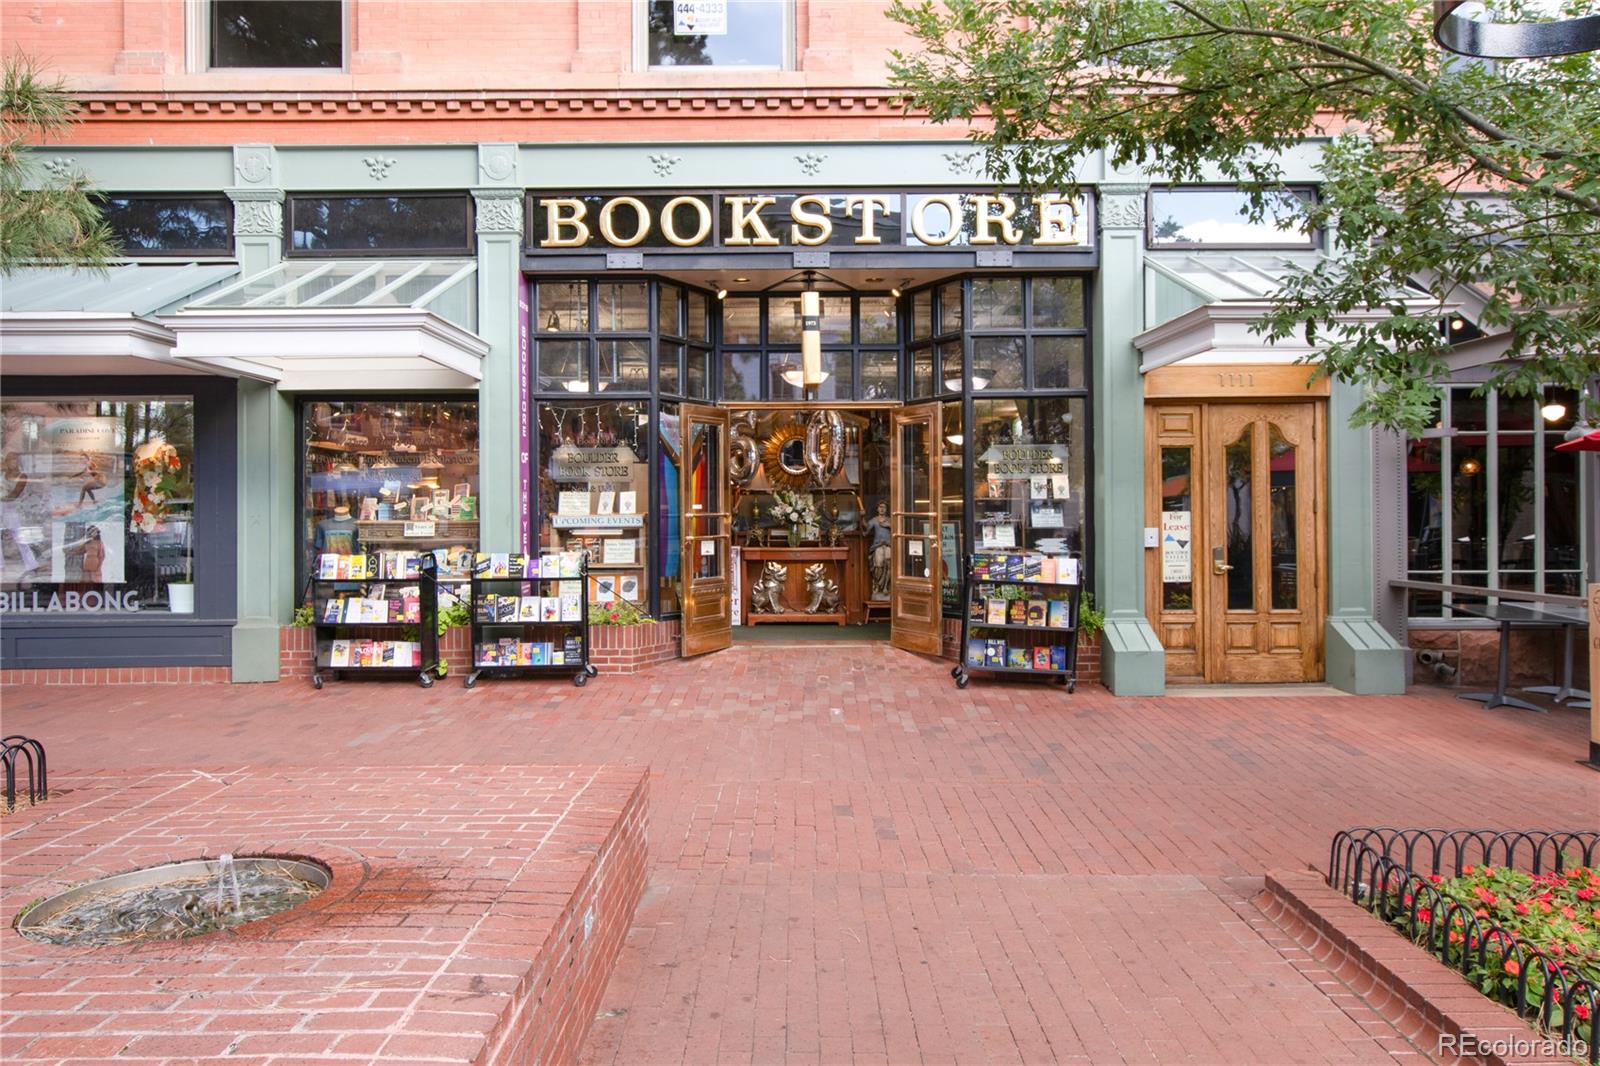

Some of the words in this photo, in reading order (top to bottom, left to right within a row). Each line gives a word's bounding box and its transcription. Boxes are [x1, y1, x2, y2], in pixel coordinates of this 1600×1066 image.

[677, 3, 724, 14] 444-4333
[539, 194, 1080, 248] BOOKSTORE
[1216, 373, 1255, 388] 1111
[567, 452, 620, 464] BOULDER
[1002, 448, 1054, 460] BOULDER
[560, 466, 590, 477] BOOK
[594, 466, 629, 477] STORE
[994, 463, 1026, 474] BOOK
[1029, 463, 1064, 474] STORE
[607, 516, 641, 525] EVENTS
[1169, 513, 1183, 521] For
[1163, 522, 1190, 531] Lease
[0, 590, 139, 613] BILLABONG
